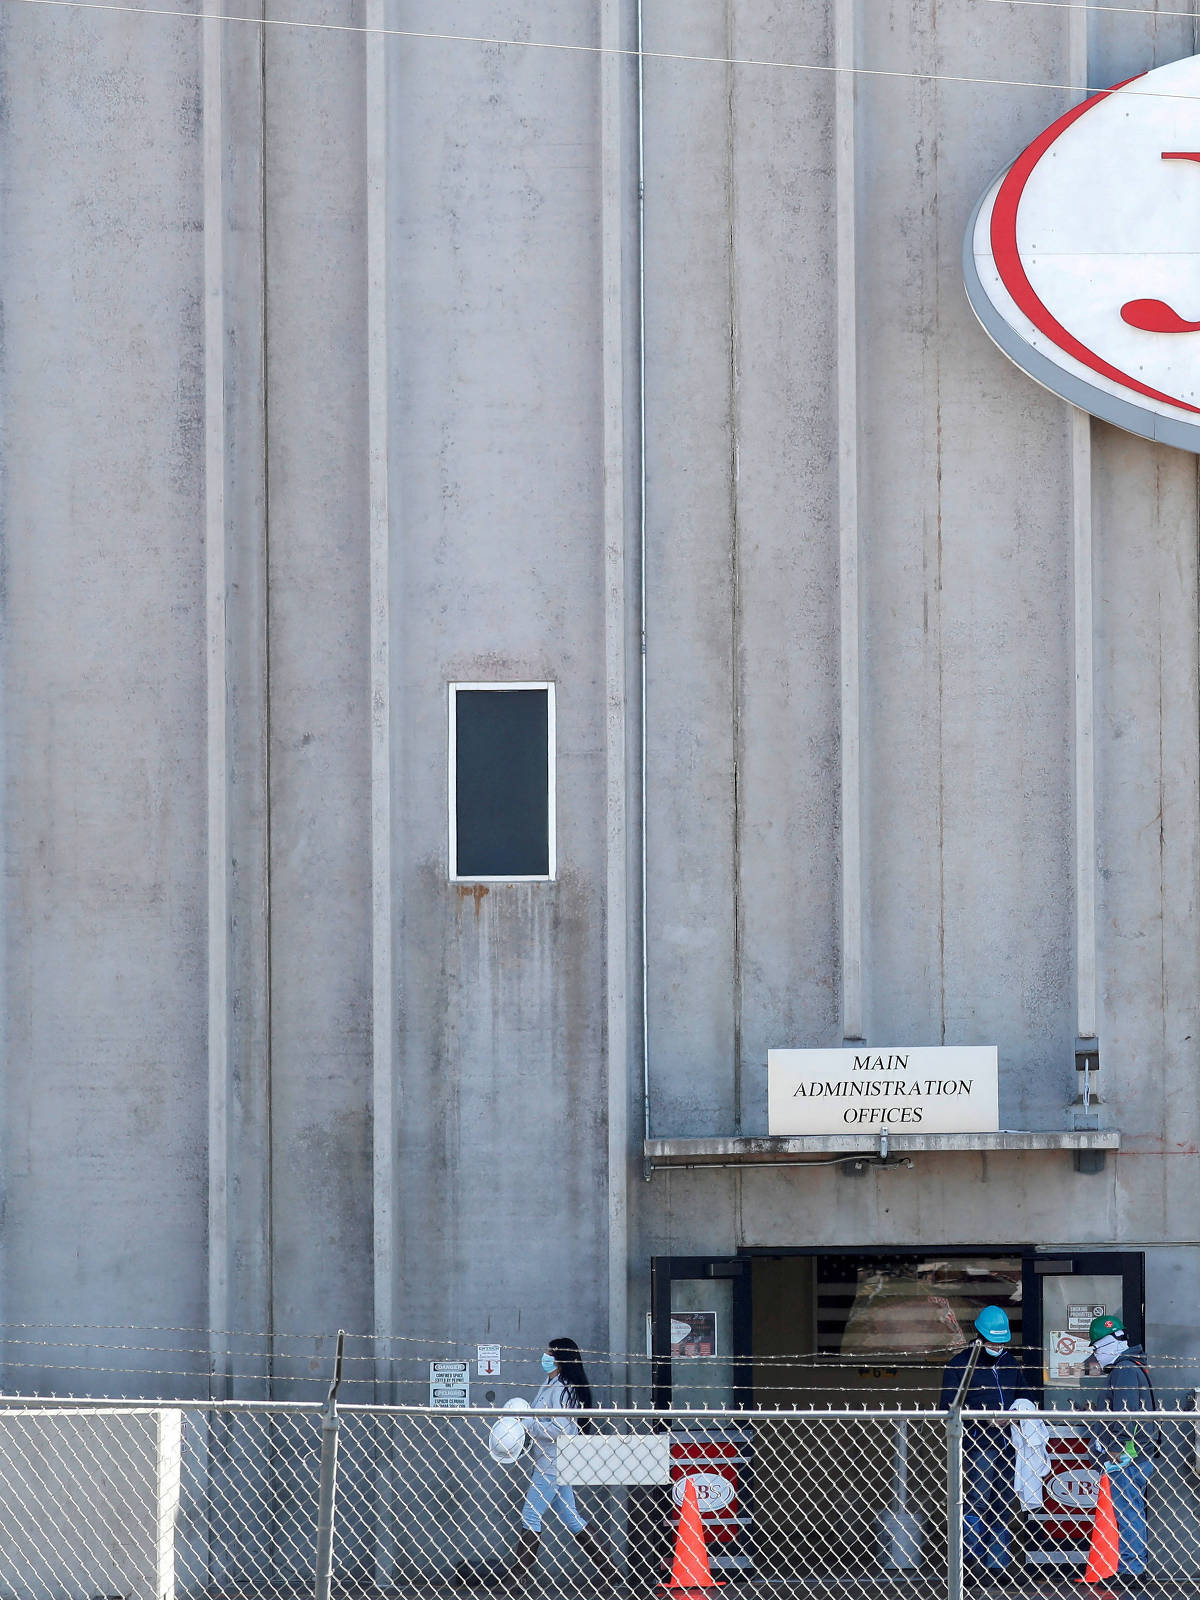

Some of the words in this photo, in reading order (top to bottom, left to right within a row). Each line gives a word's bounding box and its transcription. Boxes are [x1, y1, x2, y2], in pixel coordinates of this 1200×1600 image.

[852, 1055, 910, 1071] MAIN
[793, 1079, 974, 1097] ADMINISTRATION
[843, 1107, 923, 1123] OFFICES
[697, 1485, 721, 1499] BS
